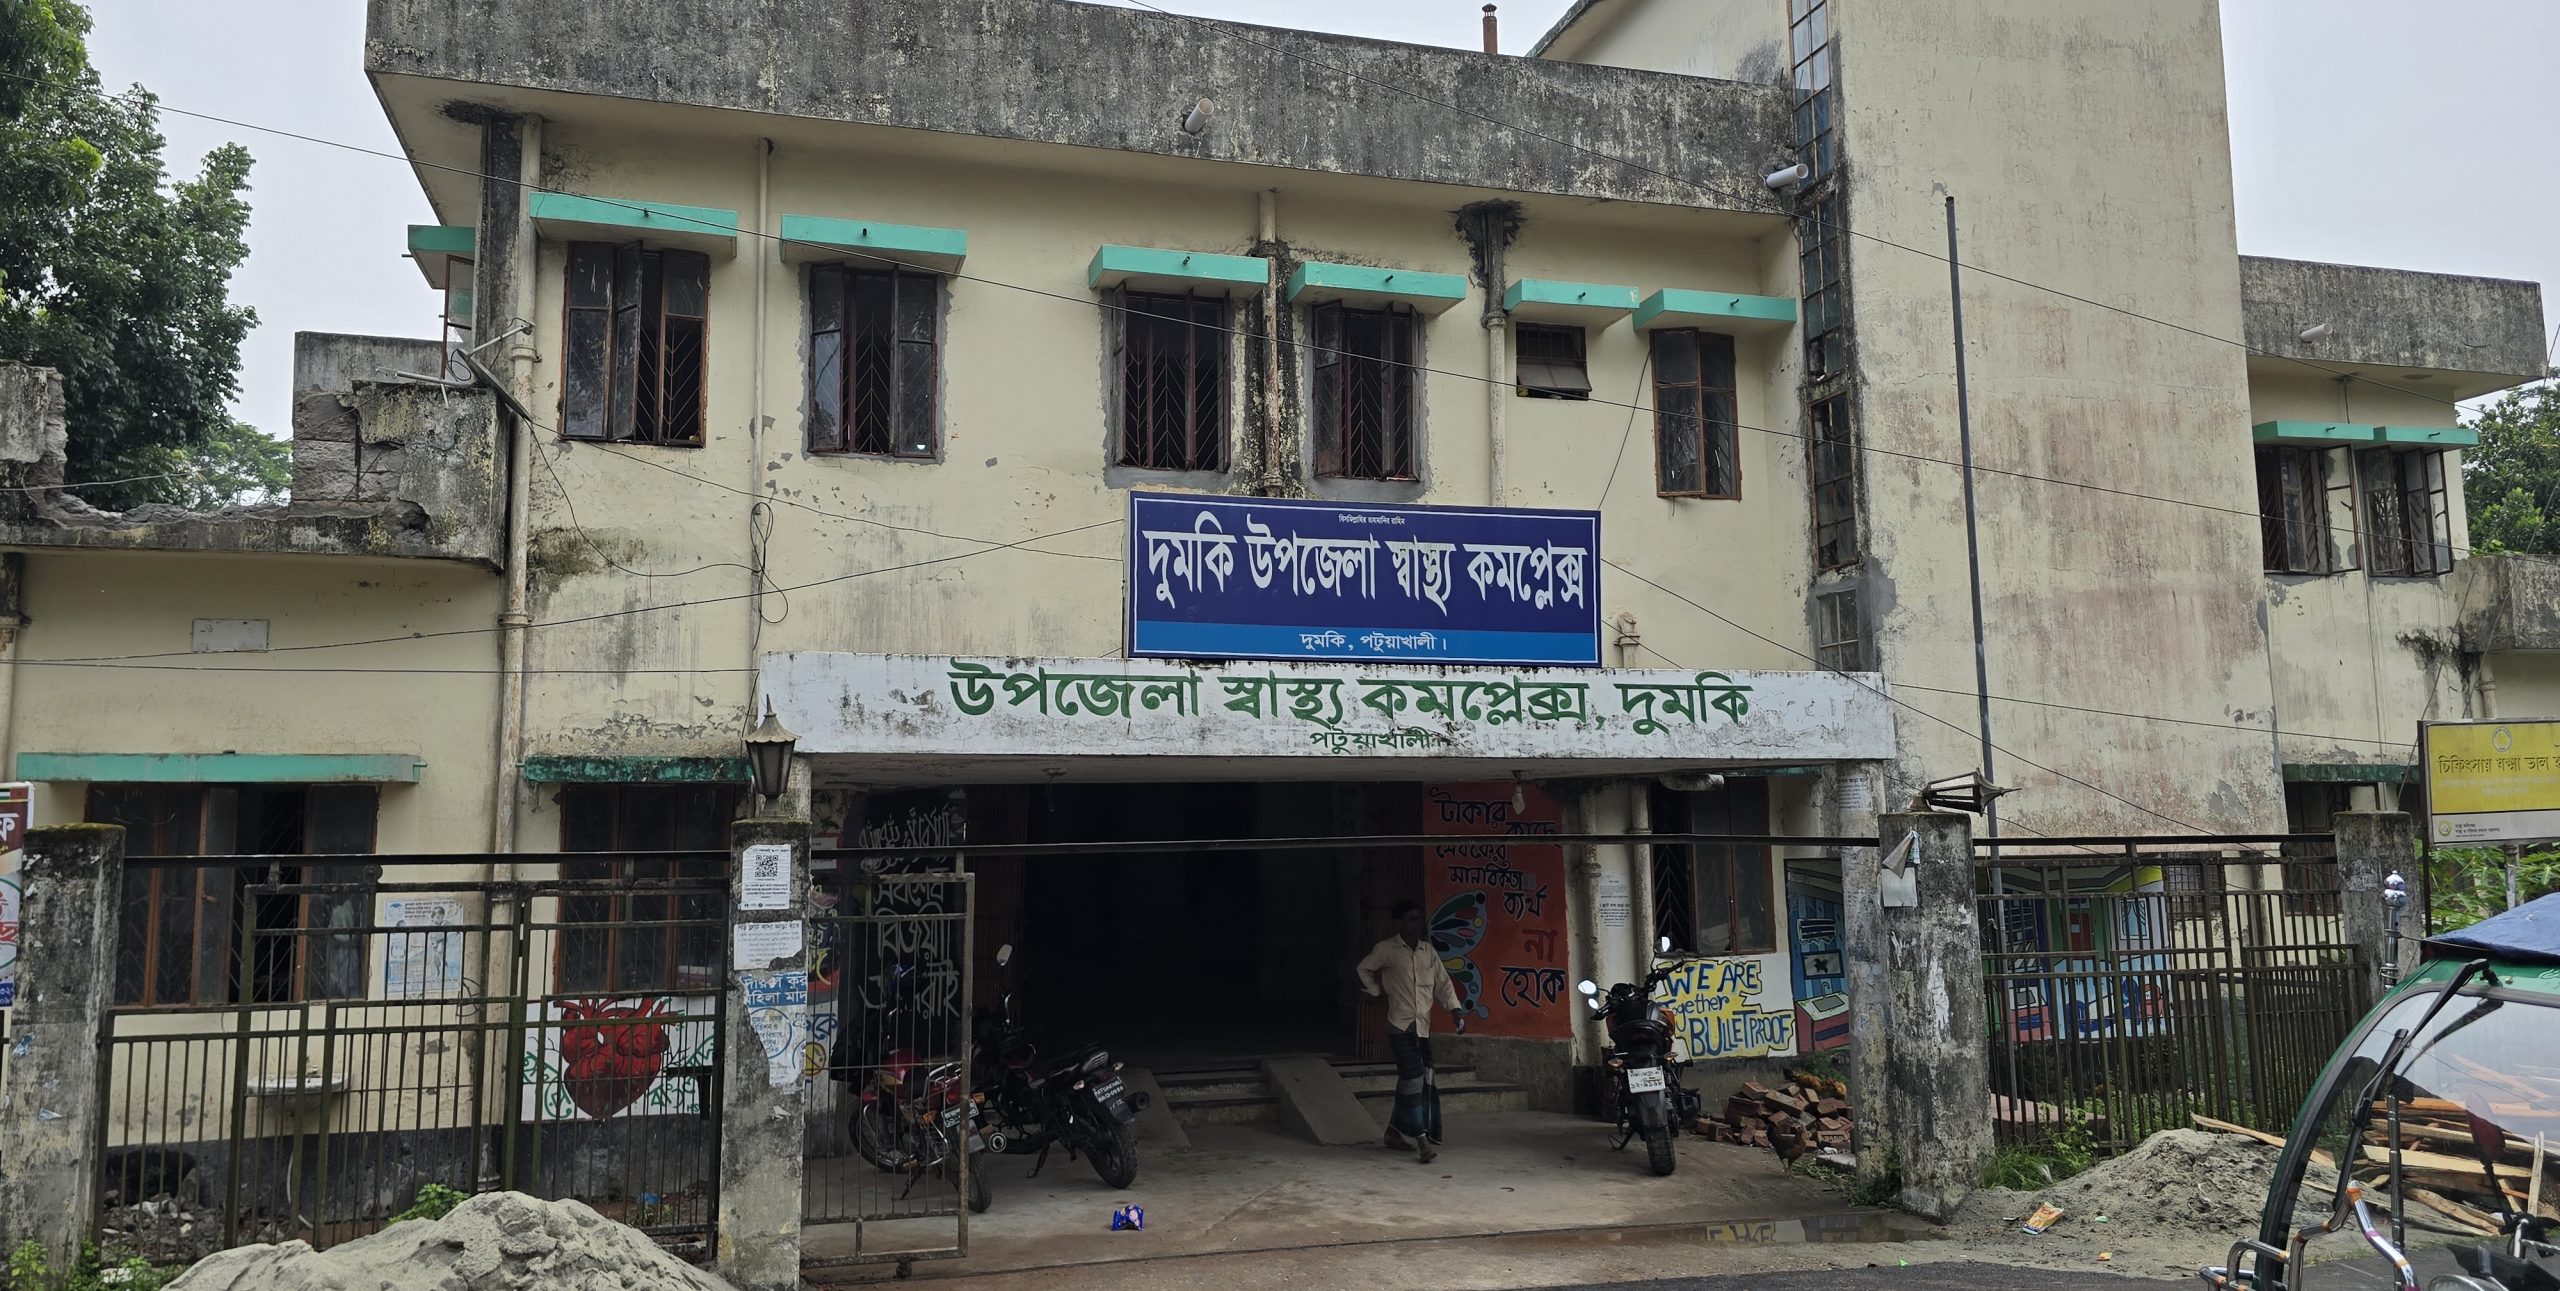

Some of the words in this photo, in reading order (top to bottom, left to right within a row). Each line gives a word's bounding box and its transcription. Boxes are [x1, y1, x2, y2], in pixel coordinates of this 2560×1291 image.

[1142, 510, 1238, 609] দুমকি
[1243, 513, 1381, 600] উপজেলা
[1384, 534, 1457, 617] স্বাস্থ্য
[1462, 538, 1589, 610] কমপ্লেক্স
[946, 657, 1203, 718] উপজেলা
[1217, 669, 1345, 730] স্বাস্থ্য
[1613, 671, 1754, 735] দুমকি
[1429, 786, 1513, 829] টাকার
[1504, 885, 1548, 920] ব্যর্থ
[1521, 929, 1558, 962] না
[1500, 966, 1566, 1008] হোক
[1666, 964, 1714, 997] WE
[1717, 963, 1759, 993] ARE
